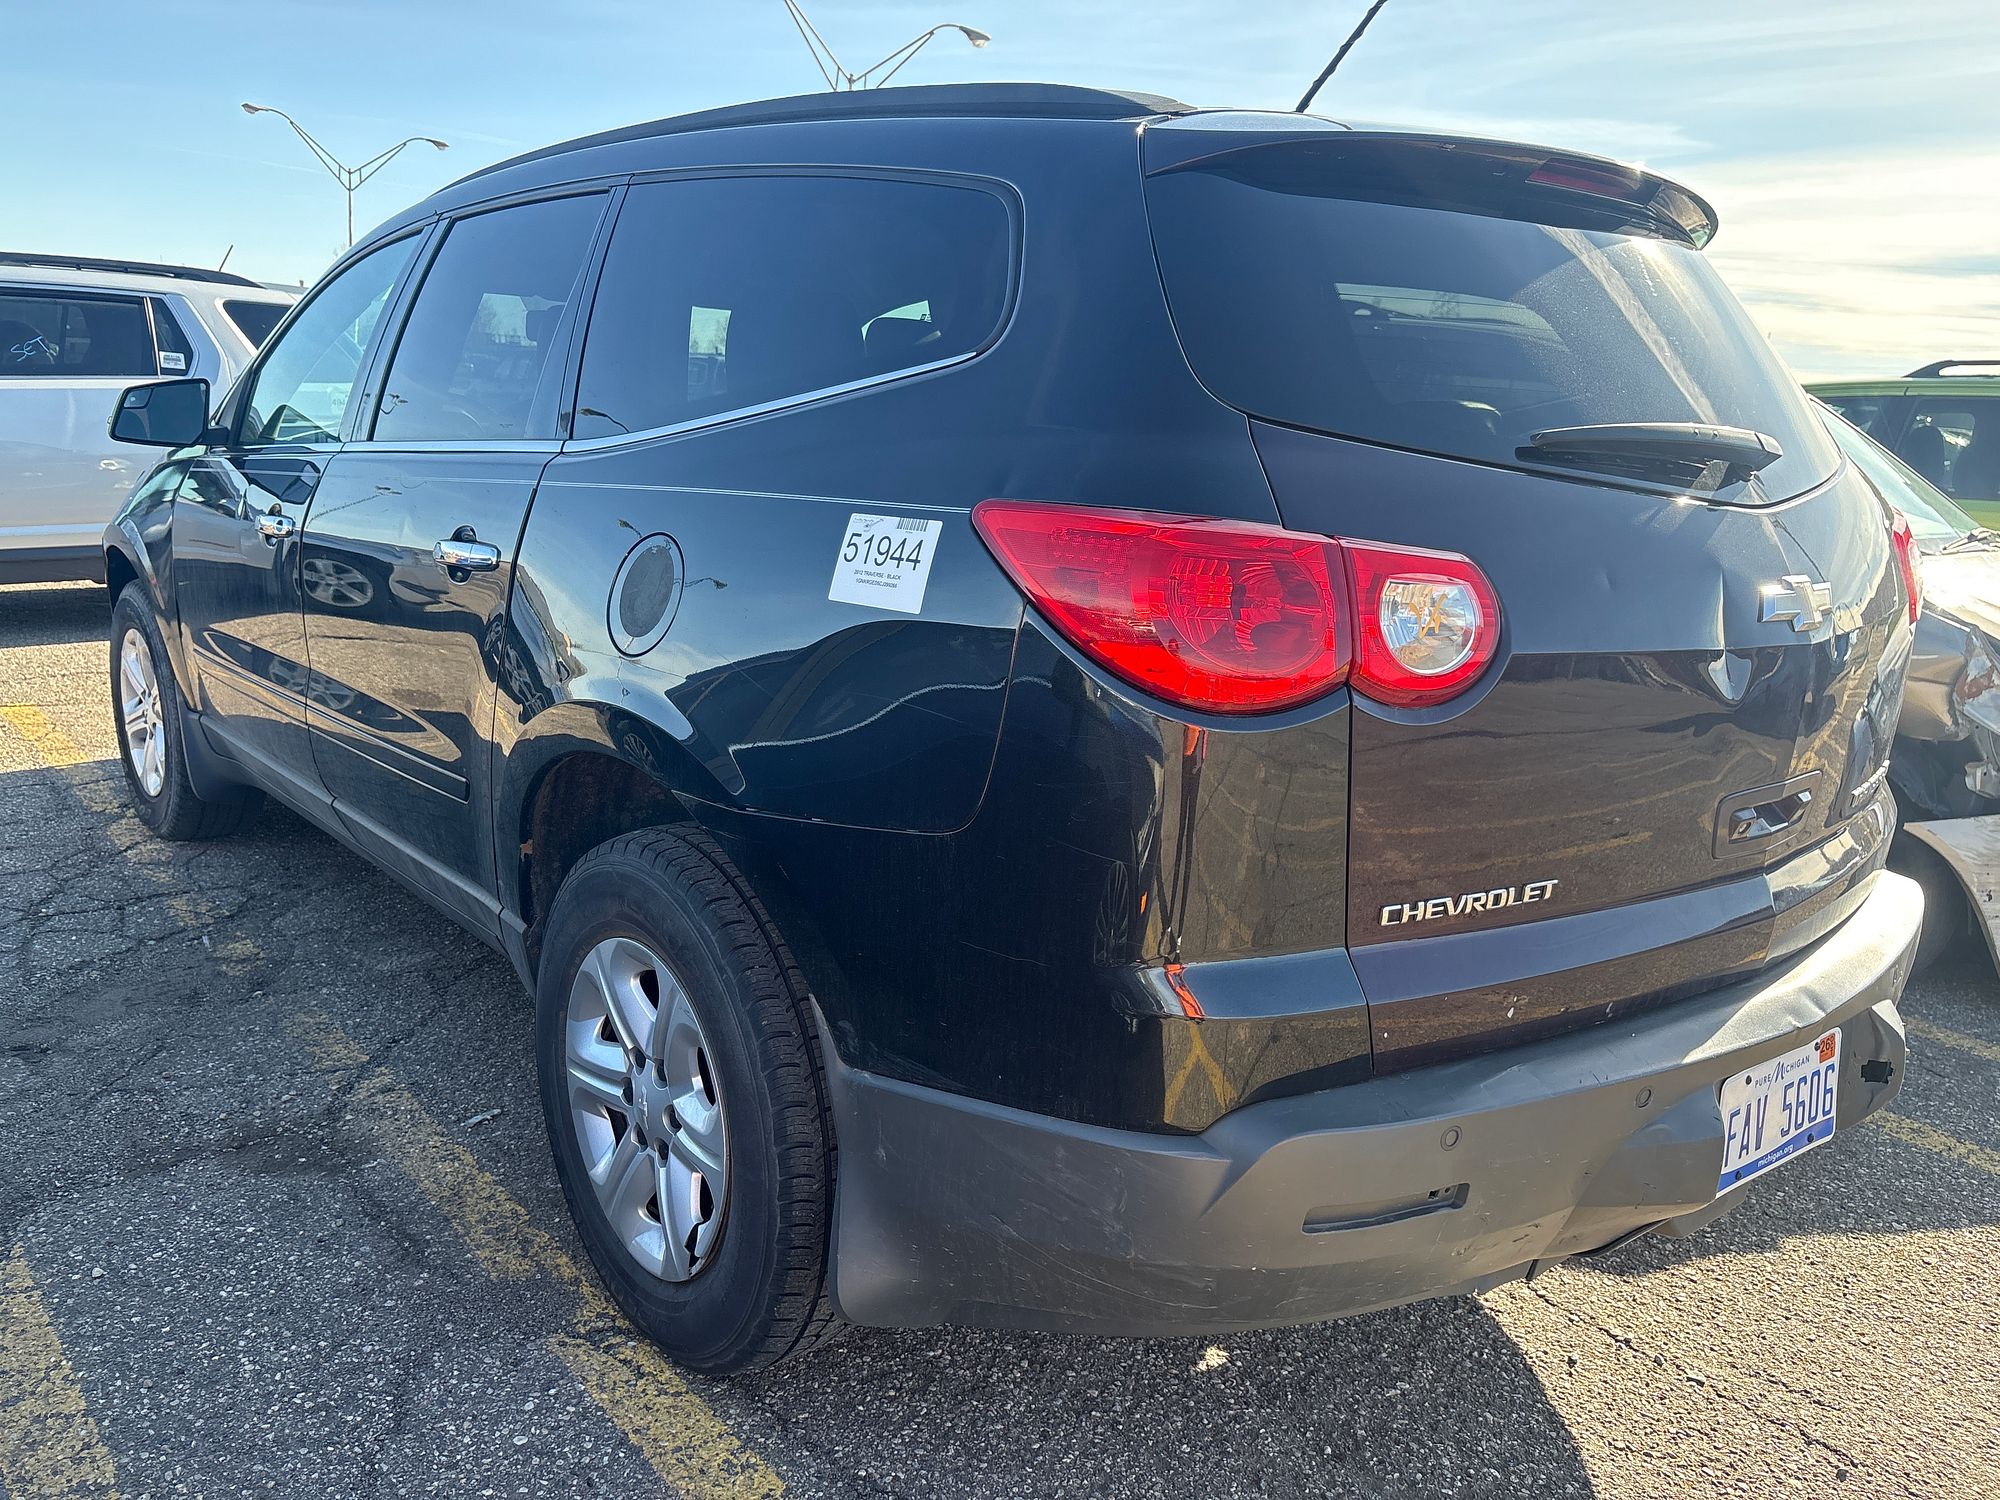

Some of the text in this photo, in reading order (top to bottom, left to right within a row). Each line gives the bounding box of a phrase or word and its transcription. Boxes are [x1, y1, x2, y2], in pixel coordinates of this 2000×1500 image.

[843, 532, 924, 571] 51944
[864, 570, 884, 578] TRAVERSE
[1379, 880, 1558, 926] CHEVROLET
[1820, 1038, 1831, 1053] 26
[1754, 1055, 1811, 1089] PURE MICHIGAN
[1724, 1062, 1835, 1168] FAV 5606
[1757, 1144, 1794, 1168] michigan.org
